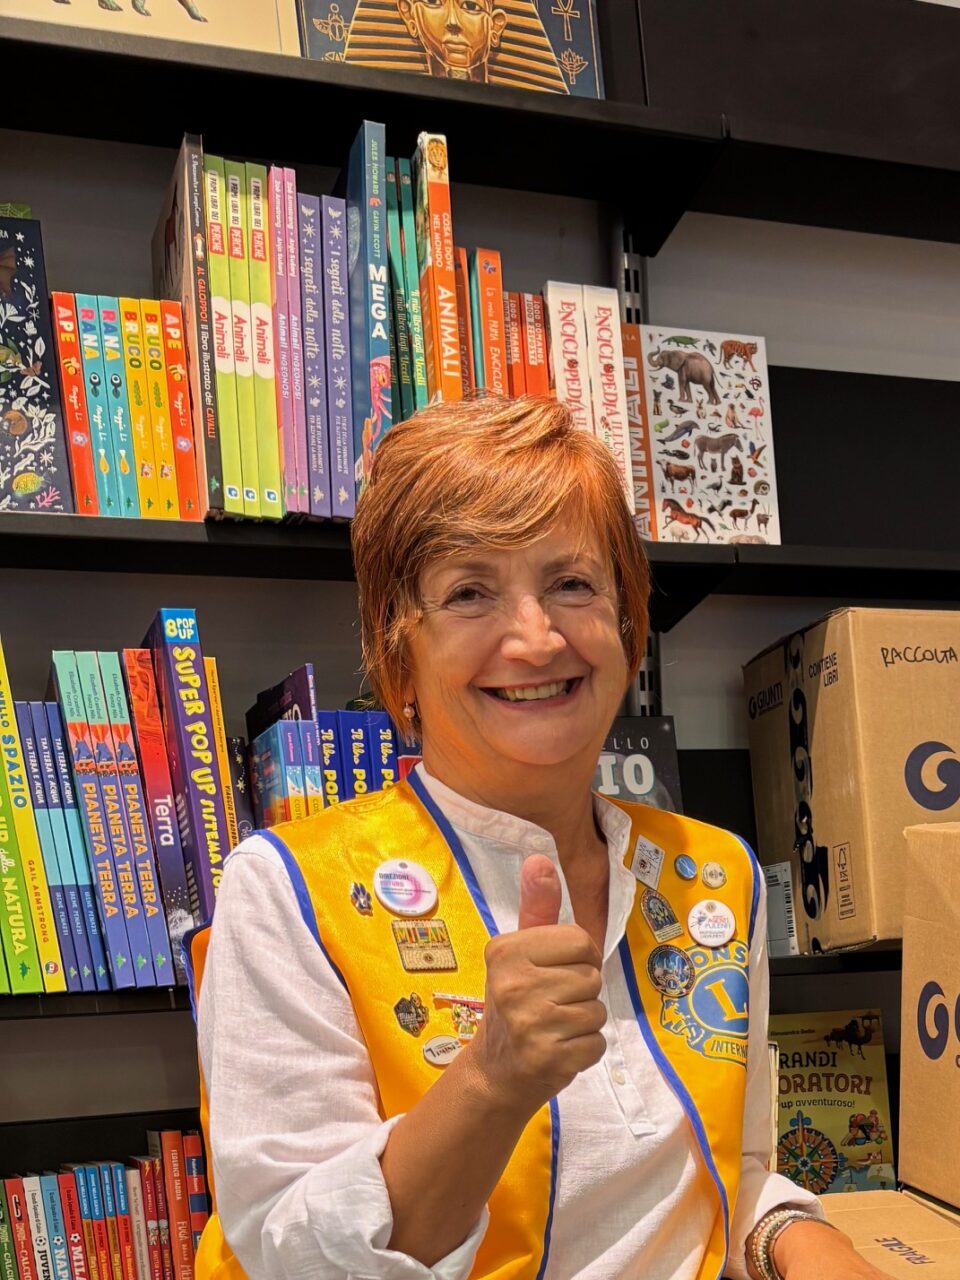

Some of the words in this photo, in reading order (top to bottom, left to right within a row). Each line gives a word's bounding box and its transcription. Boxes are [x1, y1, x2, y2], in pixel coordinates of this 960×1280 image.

[434, 232, 443, 268] MONDO
[300, 256, 319, 294] segreti
[327, 258, 345, 296] segreti
[306, 298, 319, 323] della
[332, 299, 344, 325] della
[369, 264, 387, 340] MEGA
[56, 307, 75, 343] APE
[80, 308, 99, 360] RANA
[103, 310, 120, 360] RANA
[125, 311, 142, 369] BRUCO
[145, 313, 162, 371] BRUCO
[165, 313, 182, 350] APE
[201, 332, 209, 350] libro
[214, 310, 230, 360] Animali
[234, 314, 249, 363] Animali
[256, 316, 270, 365] Animali
[305, 327, 320, 359] notte
[437, 285, 460, 377] ANIMALI
[332, 329, 346, 360] notte
[202, 351, 211, 390] illustrato
[165, 619, 178, 638] 8
[176, 618, 195, 629] POP
[178, 628, 194, 640] UP
[808, 652, 838, 679] CONTIENE
[881, 646, 958, 667] RACCOLTA
[173, 646, 205, 716] SUPER
[185, 720, 212, 764] POP
[2, 734, 27, 809] SPAZIO
[191, 767, 216, 795] UP
[154, 795, 175, 846] Terra
[82, 783, 107, 856] PIANETA
[97, 859, 118, 918] TERRA
[103, 784, 128, 857] PIANETA
[117, 861, 139, 919] TERRA
[124, 784, 148, 856] PIANETA
[138, 859, 158, 918] TERRA
[2, 877, 29, 956] NATURA
[33, 885, 49, 943] ARMSTRONG
[693, 945, 749, 968] ONS
[779, 1051, 838, 1069] RANDI
[795, 1098, 855, 1108] avventuroso!
